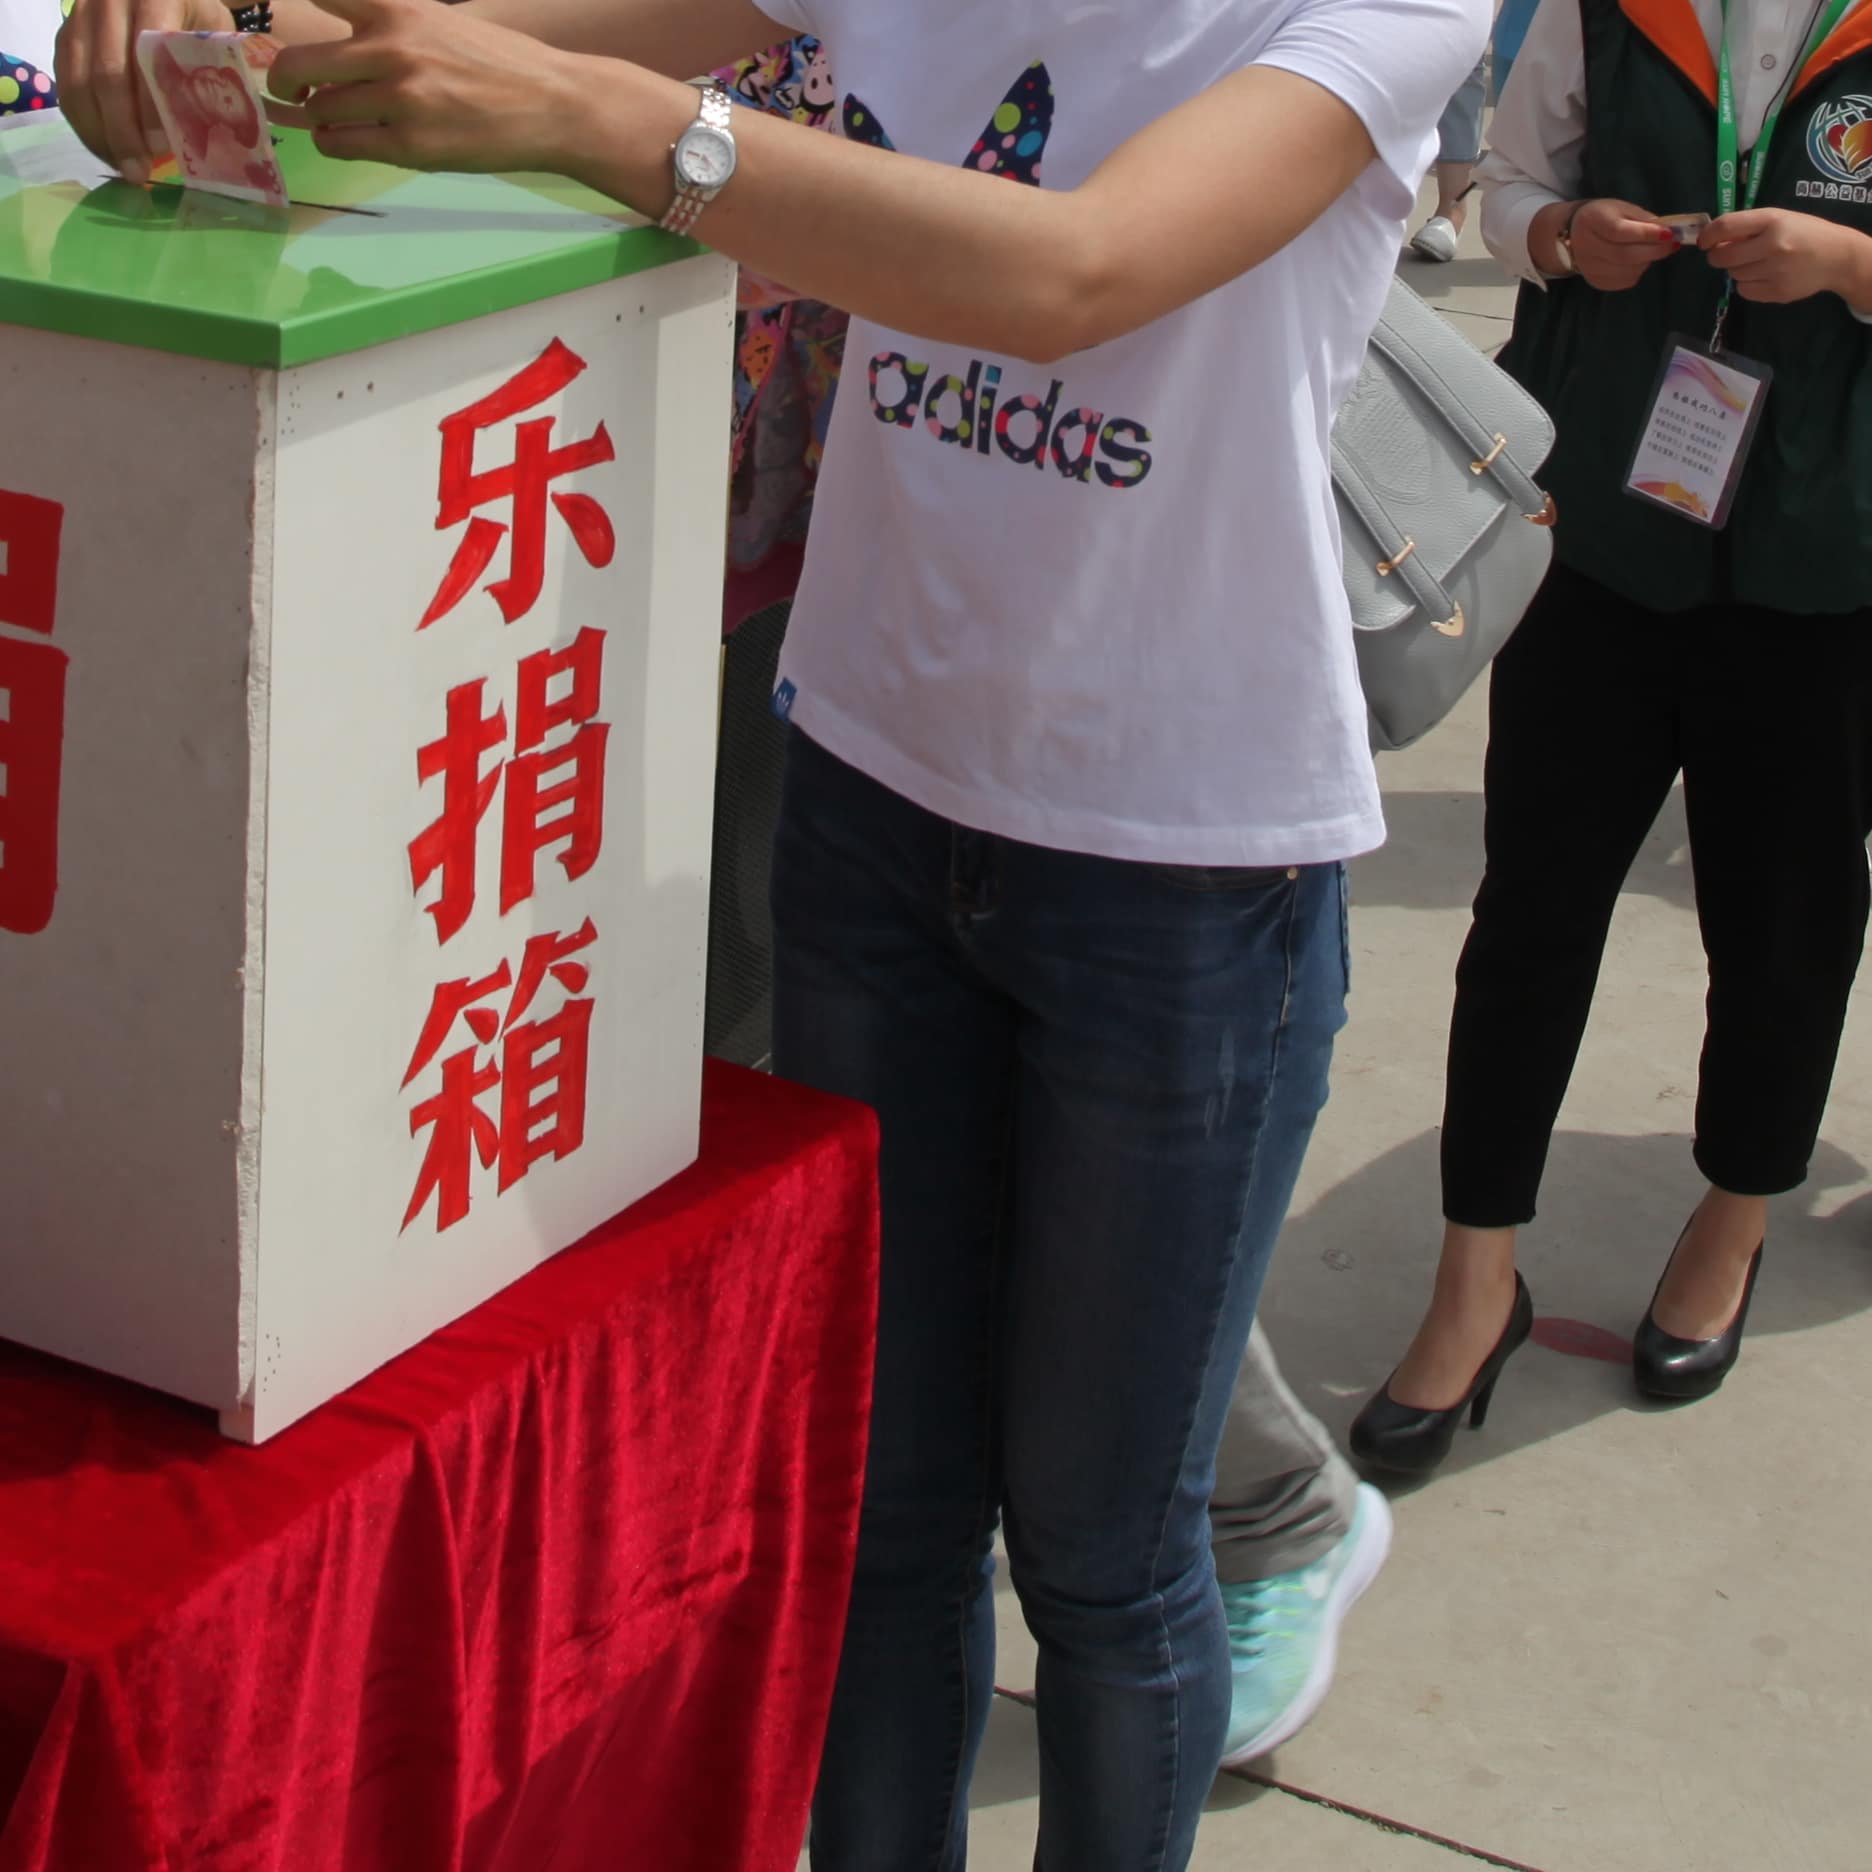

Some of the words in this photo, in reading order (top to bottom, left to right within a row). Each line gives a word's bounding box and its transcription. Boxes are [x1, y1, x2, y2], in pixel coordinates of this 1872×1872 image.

[868, 350, 1154, 489] adidas
[399, 335, 617, 1236] 乐捐箱
